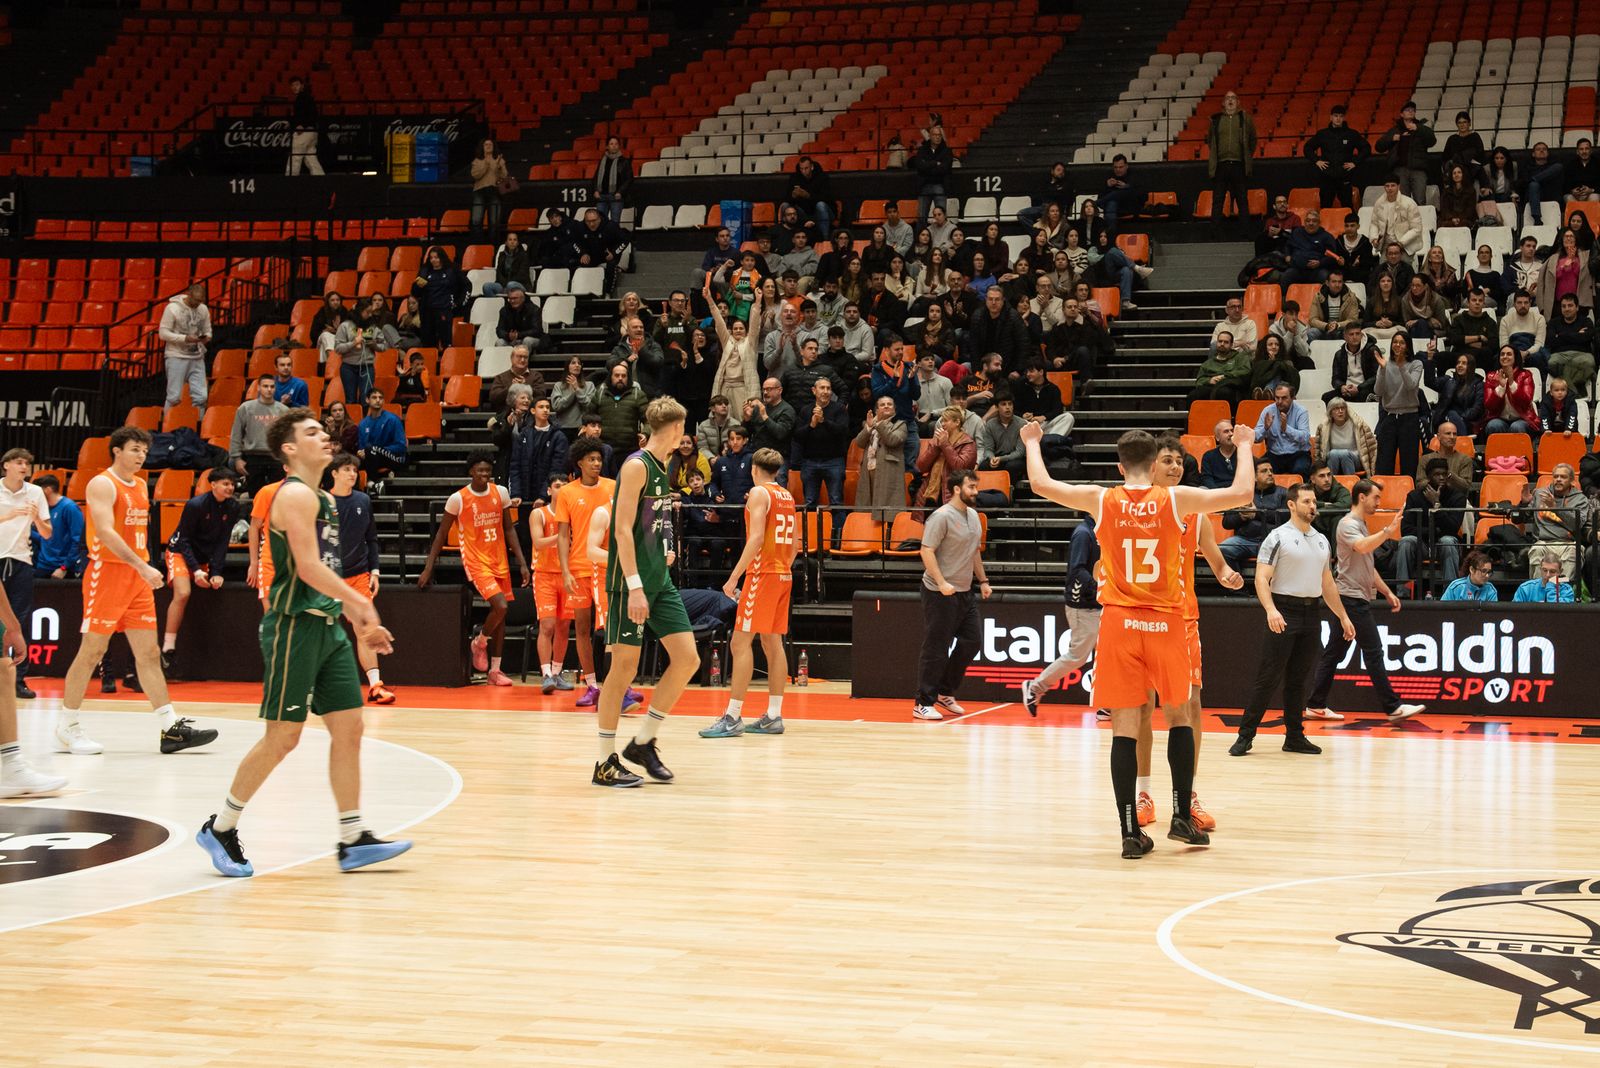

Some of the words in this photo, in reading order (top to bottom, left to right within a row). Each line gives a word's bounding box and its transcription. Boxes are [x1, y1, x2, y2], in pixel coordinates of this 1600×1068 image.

[229, 179, 256, 194] 114
[974, 176, 1002, 192] 112
[561, 188, 587, 203] 113
[483, 527, 498, 542] 33
[775, 513, 795, 545] 22
[135, 531, 146, 550] 10
[1121, 538, 1161, 584] 13
[1124, 618, 1169, 633] PAMESA
